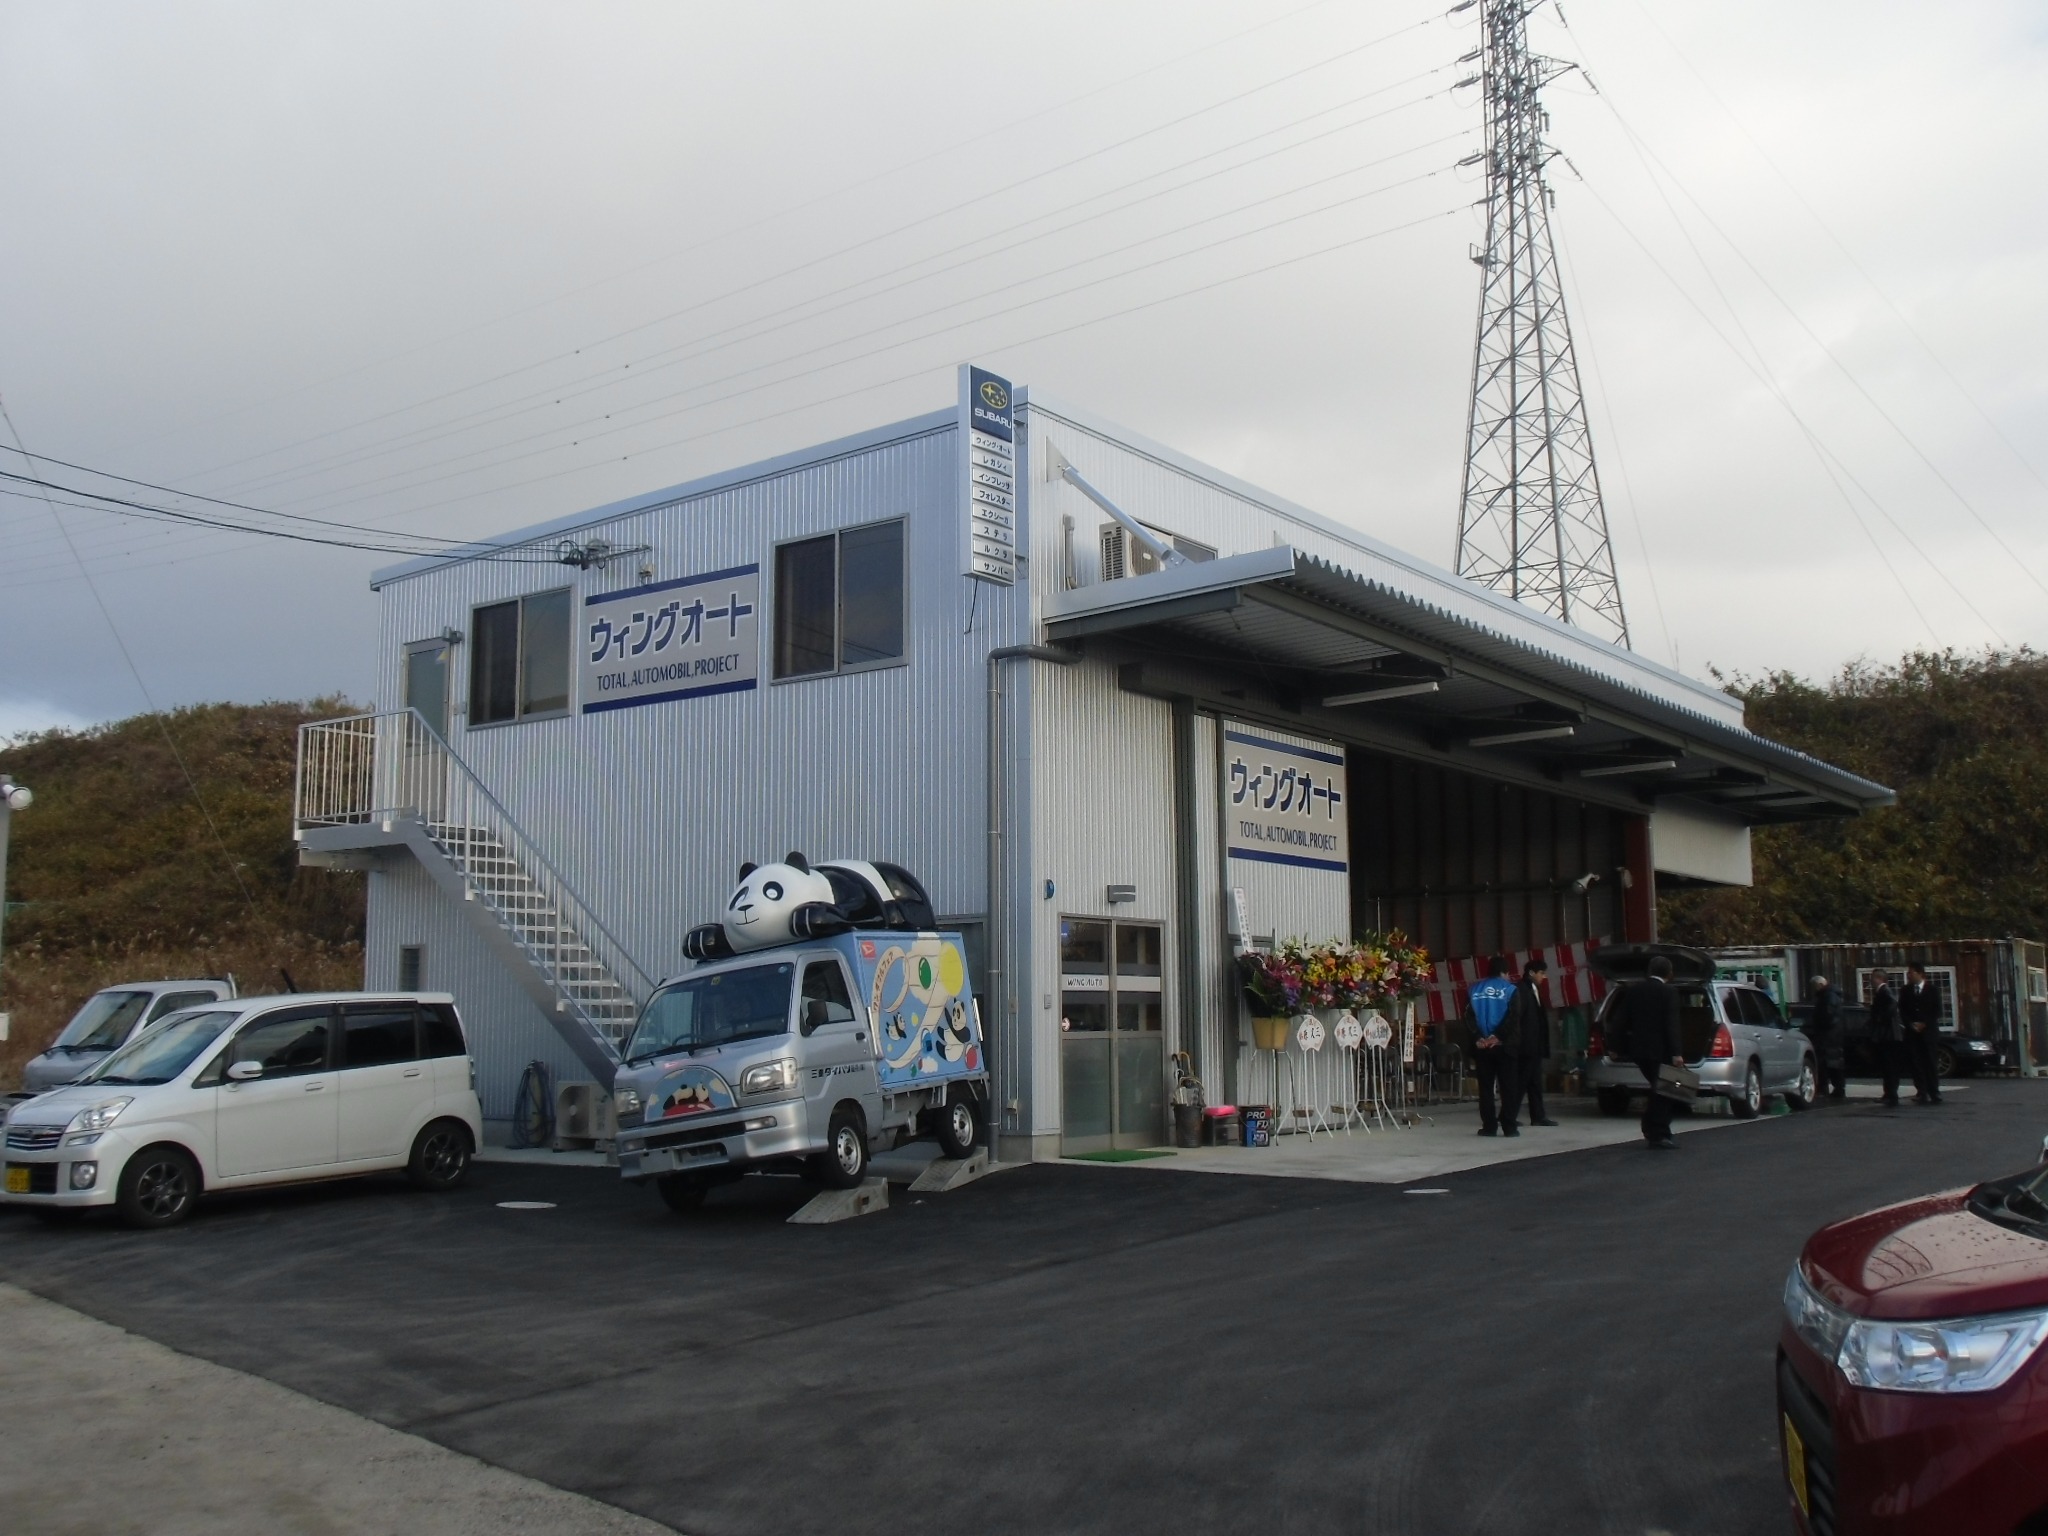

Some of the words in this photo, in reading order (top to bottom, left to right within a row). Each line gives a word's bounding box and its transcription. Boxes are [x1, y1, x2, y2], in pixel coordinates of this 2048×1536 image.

[974, 407, 1012, 429] SUBARU
[979, 473, 1010, 490] インプレッサ
[979, 490, 1011, 506] フォレスター
[981, 508, 1009, 525] エクシーガ
[984, 526, 1008, 541] ステラ
[984, 544, 1008, 559] ルクラ
[984, 562, 1009, 575] サンバー
[590, 592, 753, 663] ウィングオート
[1230, 757, 1341, 820] ウィングオート
[1246, 1110, 1266, 1119] PRO
